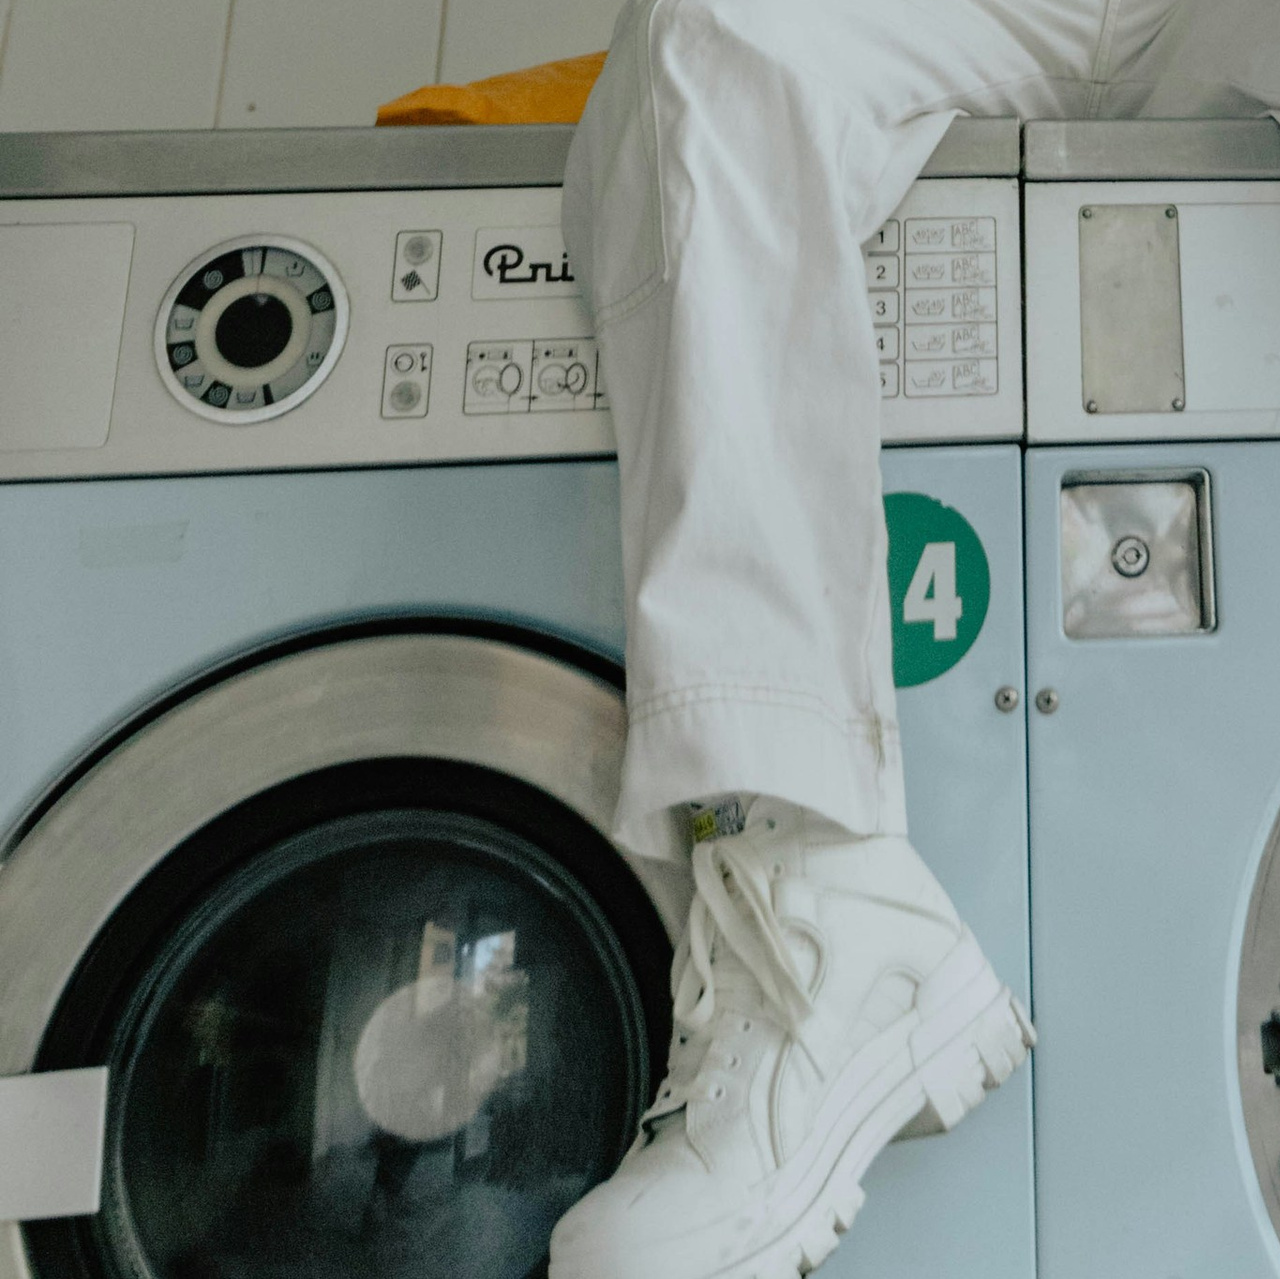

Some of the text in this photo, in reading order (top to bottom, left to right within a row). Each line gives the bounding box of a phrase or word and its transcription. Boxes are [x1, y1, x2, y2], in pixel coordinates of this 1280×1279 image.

[876, 265, 886, 279] 2
[876, 301, 886, 315] 3
[903, 541, 962, 641] 4
